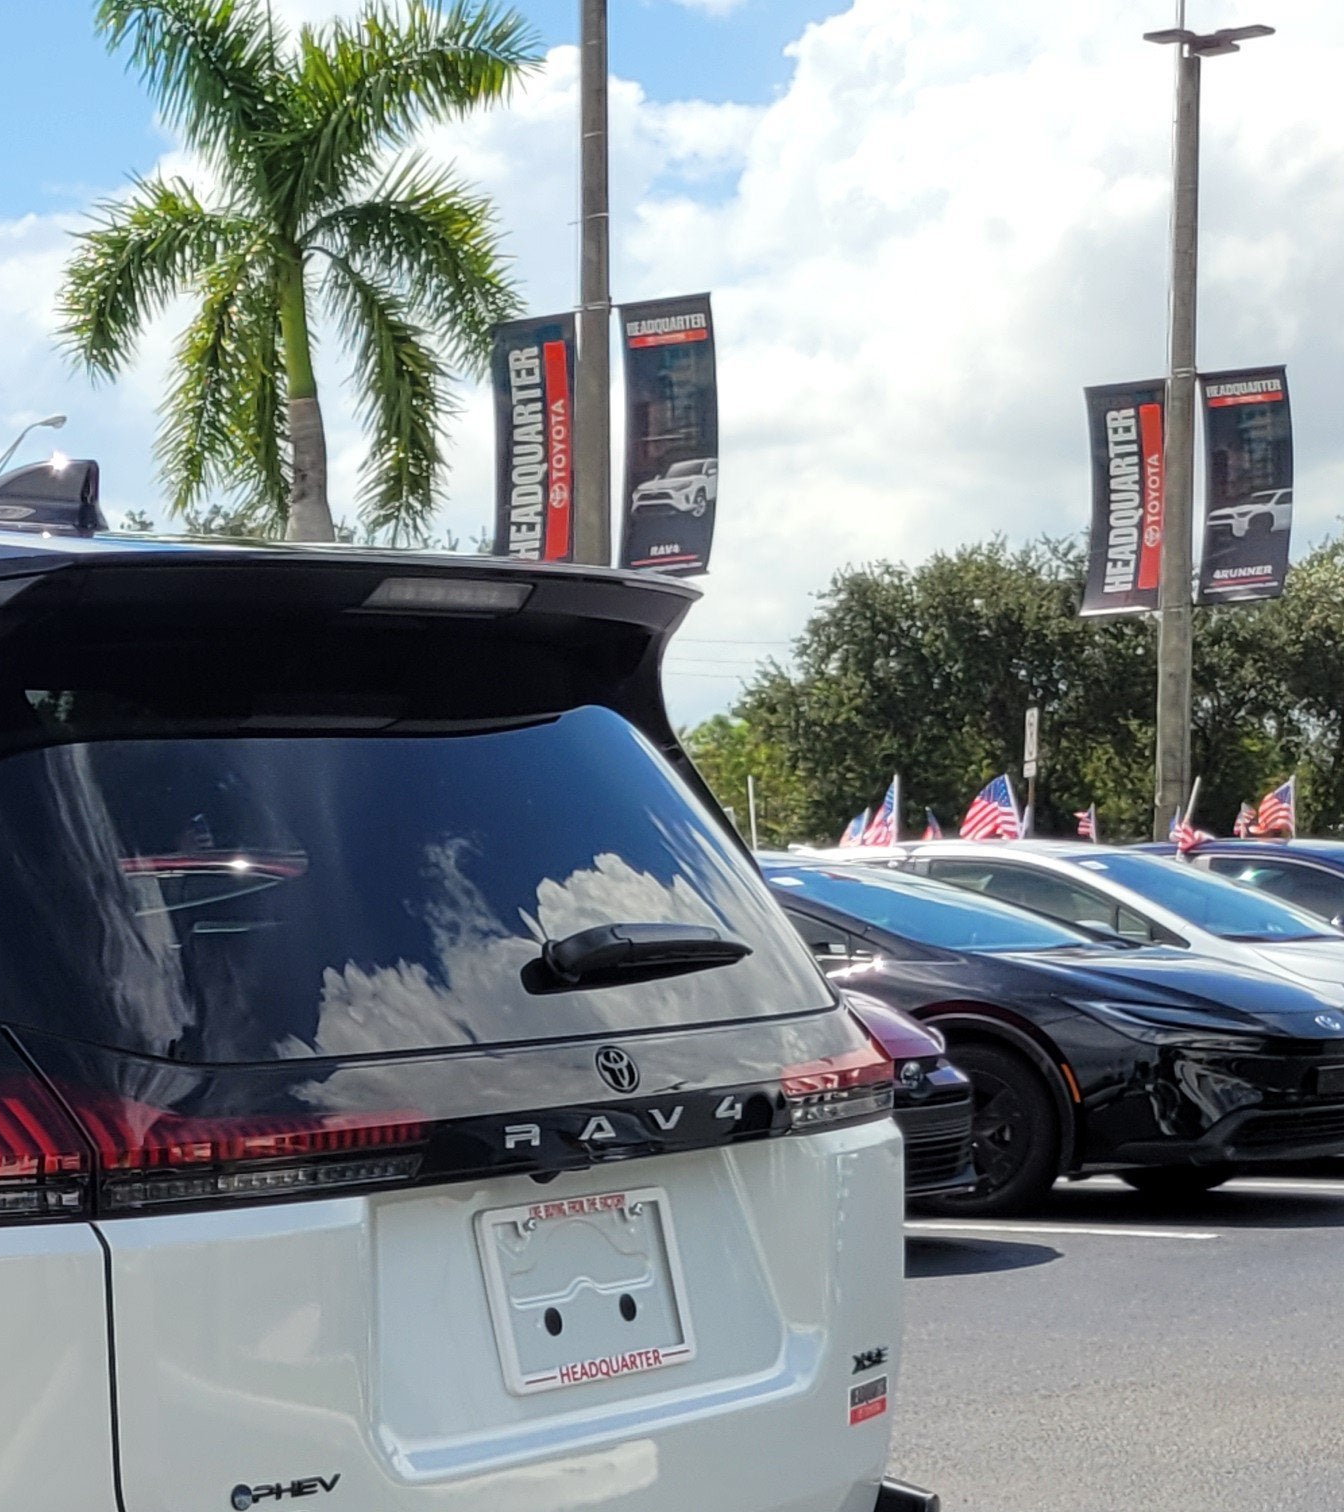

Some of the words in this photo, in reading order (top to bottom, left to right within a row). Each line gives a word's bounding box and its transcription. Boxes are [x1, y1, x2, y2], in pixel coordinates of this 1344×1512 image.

[627, 313, 706, 336] HEADQUARTER
[1205, 379, 1282, 398] HEADQUARTER
[509, 345, 548, 560] HEADQUARTER
[550, 399, 566, 477] TOYOTA
[1103, 407, 1143, 593] HEADQUARTER
[1147, 454, 1160, 523] TOYOTA
[1213, 565, 1273, 579] 4RUNNER
[559, 1349, 662, 1384] HEADQUARTER
[252, 1473, 341, 1503] PHEV
